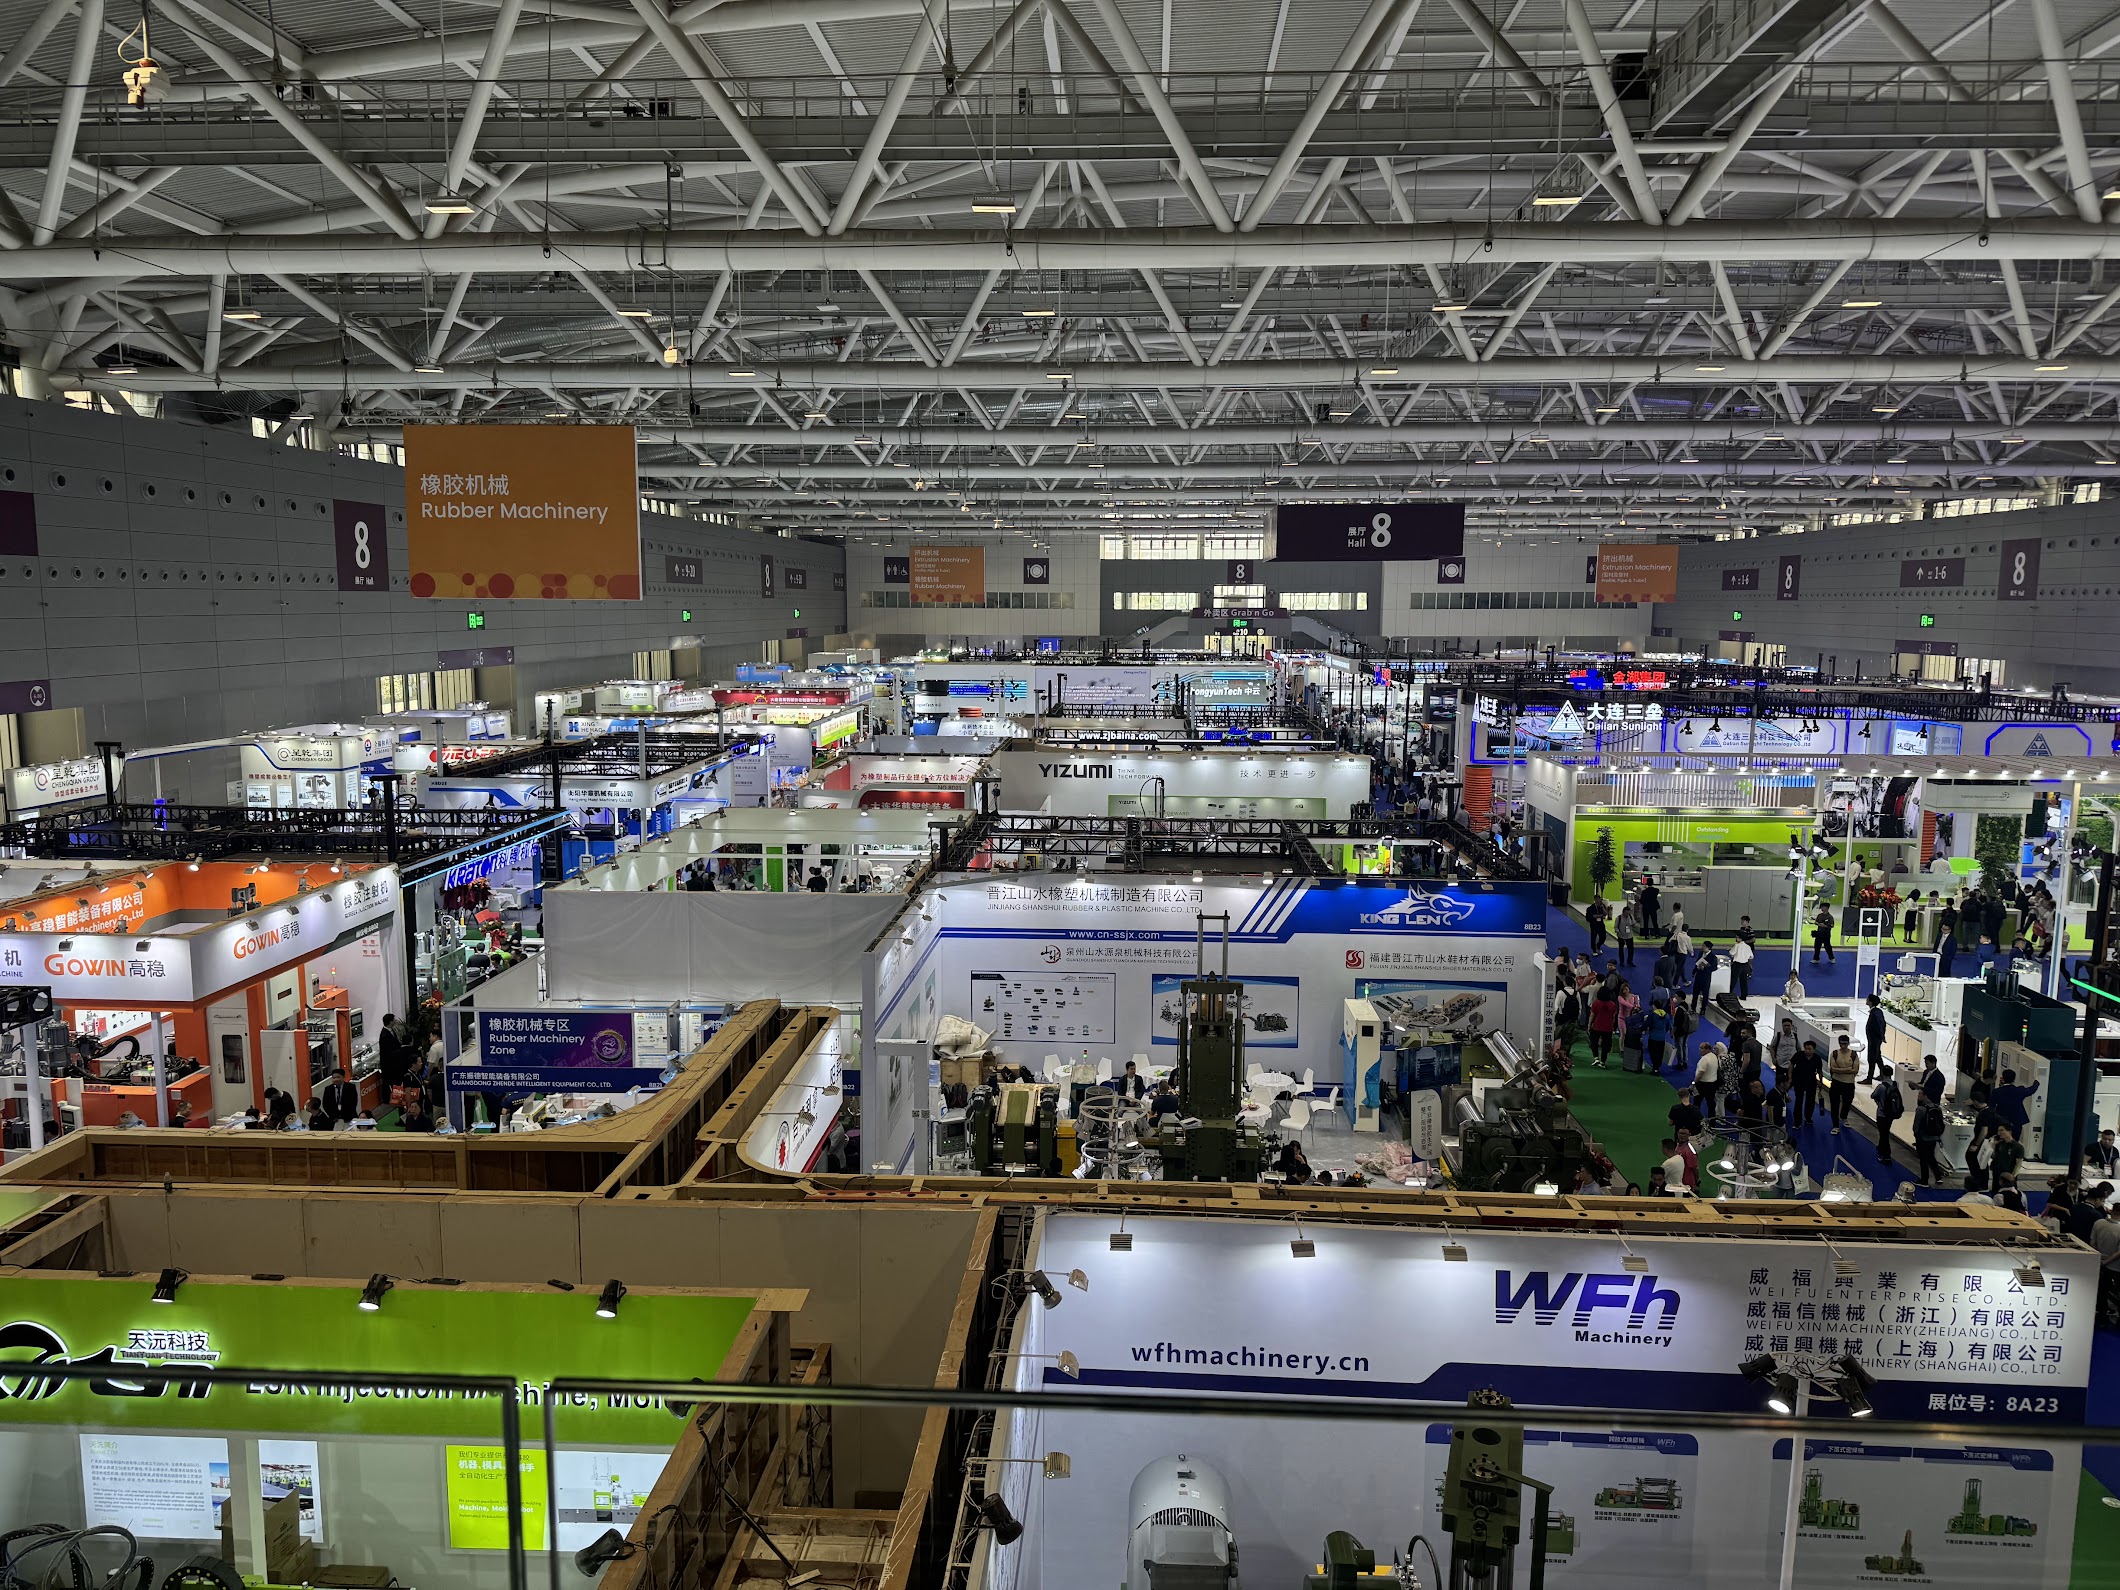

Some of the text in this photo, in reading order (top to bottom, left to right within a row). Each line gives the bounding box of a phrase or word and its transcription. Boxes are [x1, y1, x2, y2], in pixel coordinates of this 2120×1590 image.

[420, 474, 510, 496] 橡胶机械
[421, 502, 609, 525] Rubber Machinery
[1347, 526, 1367, 536] 展厅
[1348, 512, 1393, 548] Hall 8
[354, 521, 371, 569] 8
[765, 564, 771, 588] 8
[1235, 564, 1245, 579] 8
[1635, 564, 1673, 572] Machinery
[1934, 566, 1947, 580] 1-6
[2013, 552, 2026, 586] 8
[1785, 564, 1794, 590] 8
[1203, 608, 1275, 618] 外卖区 Go
[1924, 643, 1932, 654] 13
[1612, 671, 1667, 684] 金湖集团
[1244, 687, 1261, 696] 中云
[1586, 701, 1663, 721] 大连三垒
[1587, 722, 1662, 732] Dalian Sunlight
[1079, 730, 1159, 742] www.zjbaina.com
[1038, 763, 1113, 779] YIZUMI
[82, 774, 100, 785] GROUP
[1696, 826, 1729, 834] Outstanding
[986, 886, 1204, 903] 晋江山水橡塑机械制造有限公司
[1360, 913, 1399, 924] KING
[1524, 923, 1542, 931] 8B23
[1069, 930, 1160, 941] www.cn-ssjx.com
[233, 929, 280, 960] GOWIN
[4, 950, 22, 967] 机
[44, 953, 167, 978] GOWIN 高稳
[1369, 952, 1515, 966] 福建晋江市山水鞋材有限公司
[489, 1018, 571, 1032] 橡胶机械专区
[490, 1033, 586, 1046] Rubber Machinery
[490, 1045, 516, 1055] Zone
[1495, 1269, 1682, 1331] WFh
[1749, 1286, 1785, 1297] WEI
[1794, 1288, 1817, 1299] FU
[1826, 1289, 1959, 1304] ENTERPRISE
[1747, 1301, 2065, 1329] 威福信機械（浙江）有限公司
[1747, 1320, 1771, 1330] WEI
[1776, 1321, 1793, 1331] FU
[1797, 1322, 1822, 1332] XIN
[2033, 1331, 2064, 1341] LTD.
[128, 1329, 209, 1352] 天沅科技
[1574, 1330, 1673, 1348] Machinery
[1745, 1334, 2063, 1363] 威福興機械（上海）有限公司
[1131, 1342, 1370, 1376] wfhmachinery.cn
[459, 1504, 489, 1512] Machine,
